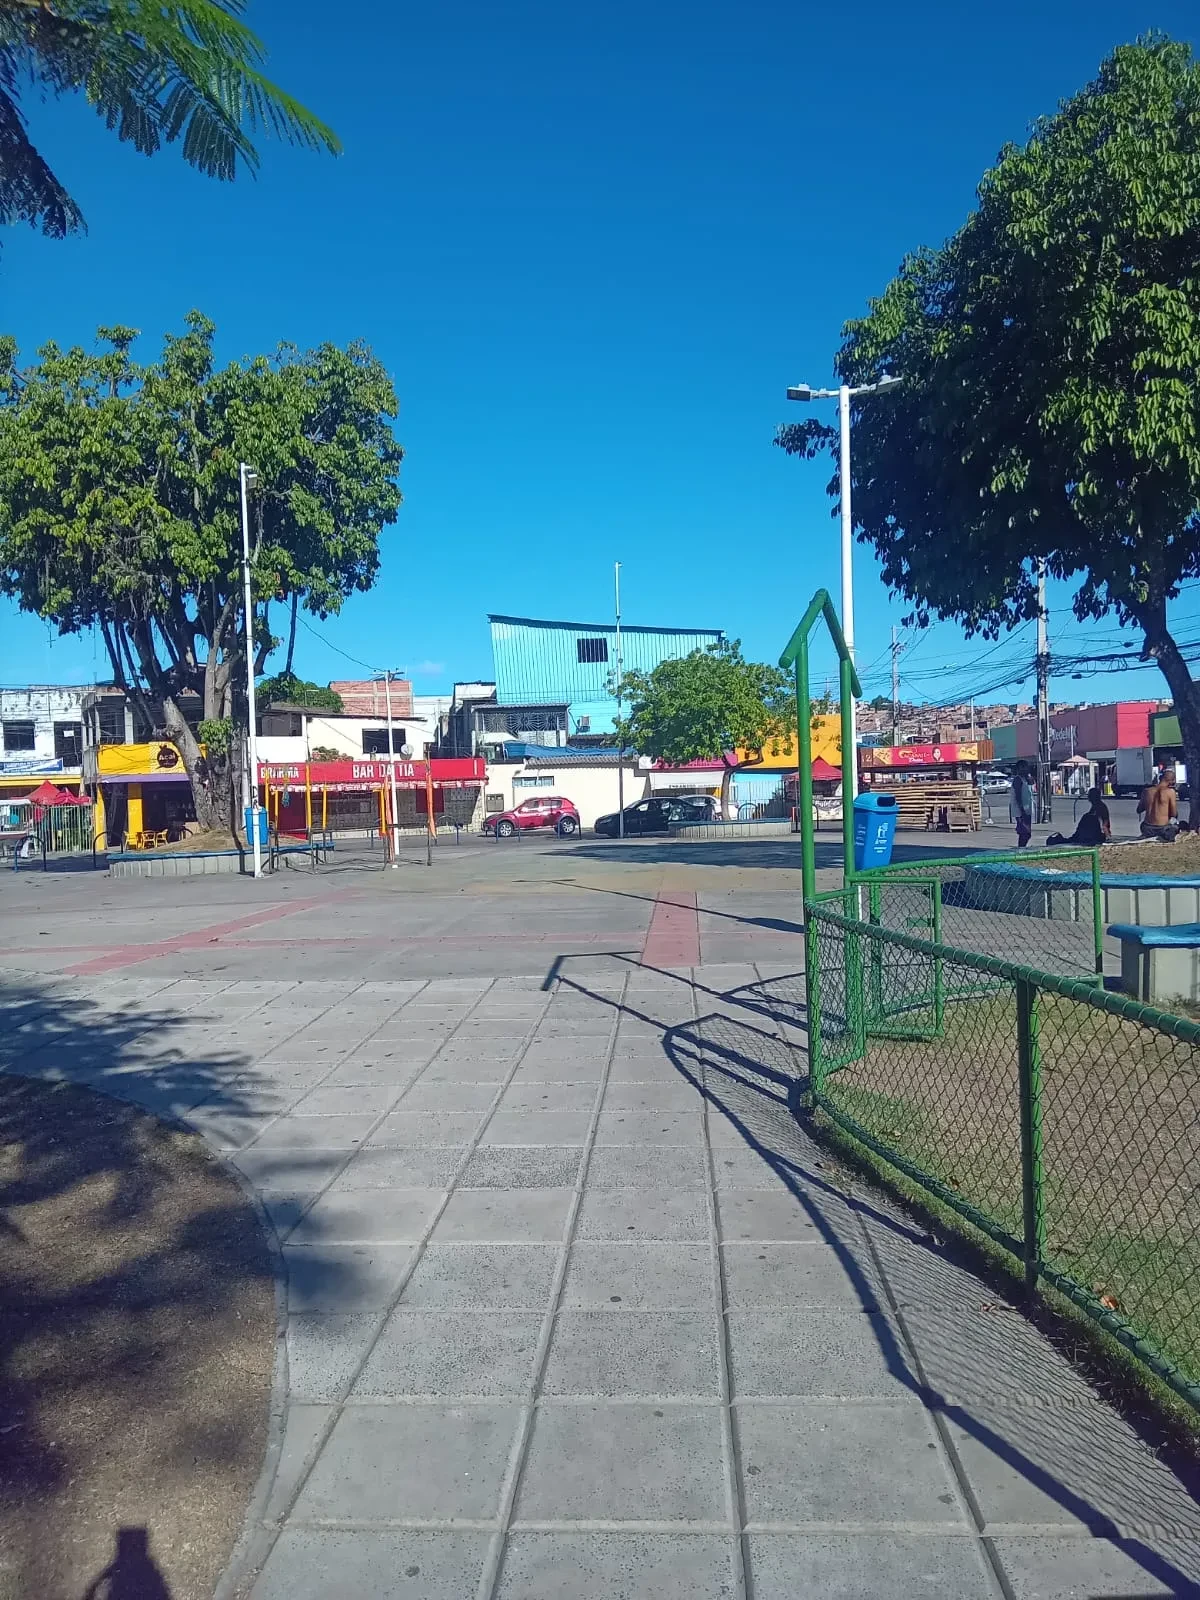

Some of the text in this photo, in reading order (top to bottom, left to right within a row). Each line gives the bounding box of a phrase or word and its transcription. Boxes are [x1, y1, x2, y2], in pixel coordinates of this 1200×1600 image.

[353, 763, 415, 778] BAR DA TIA
